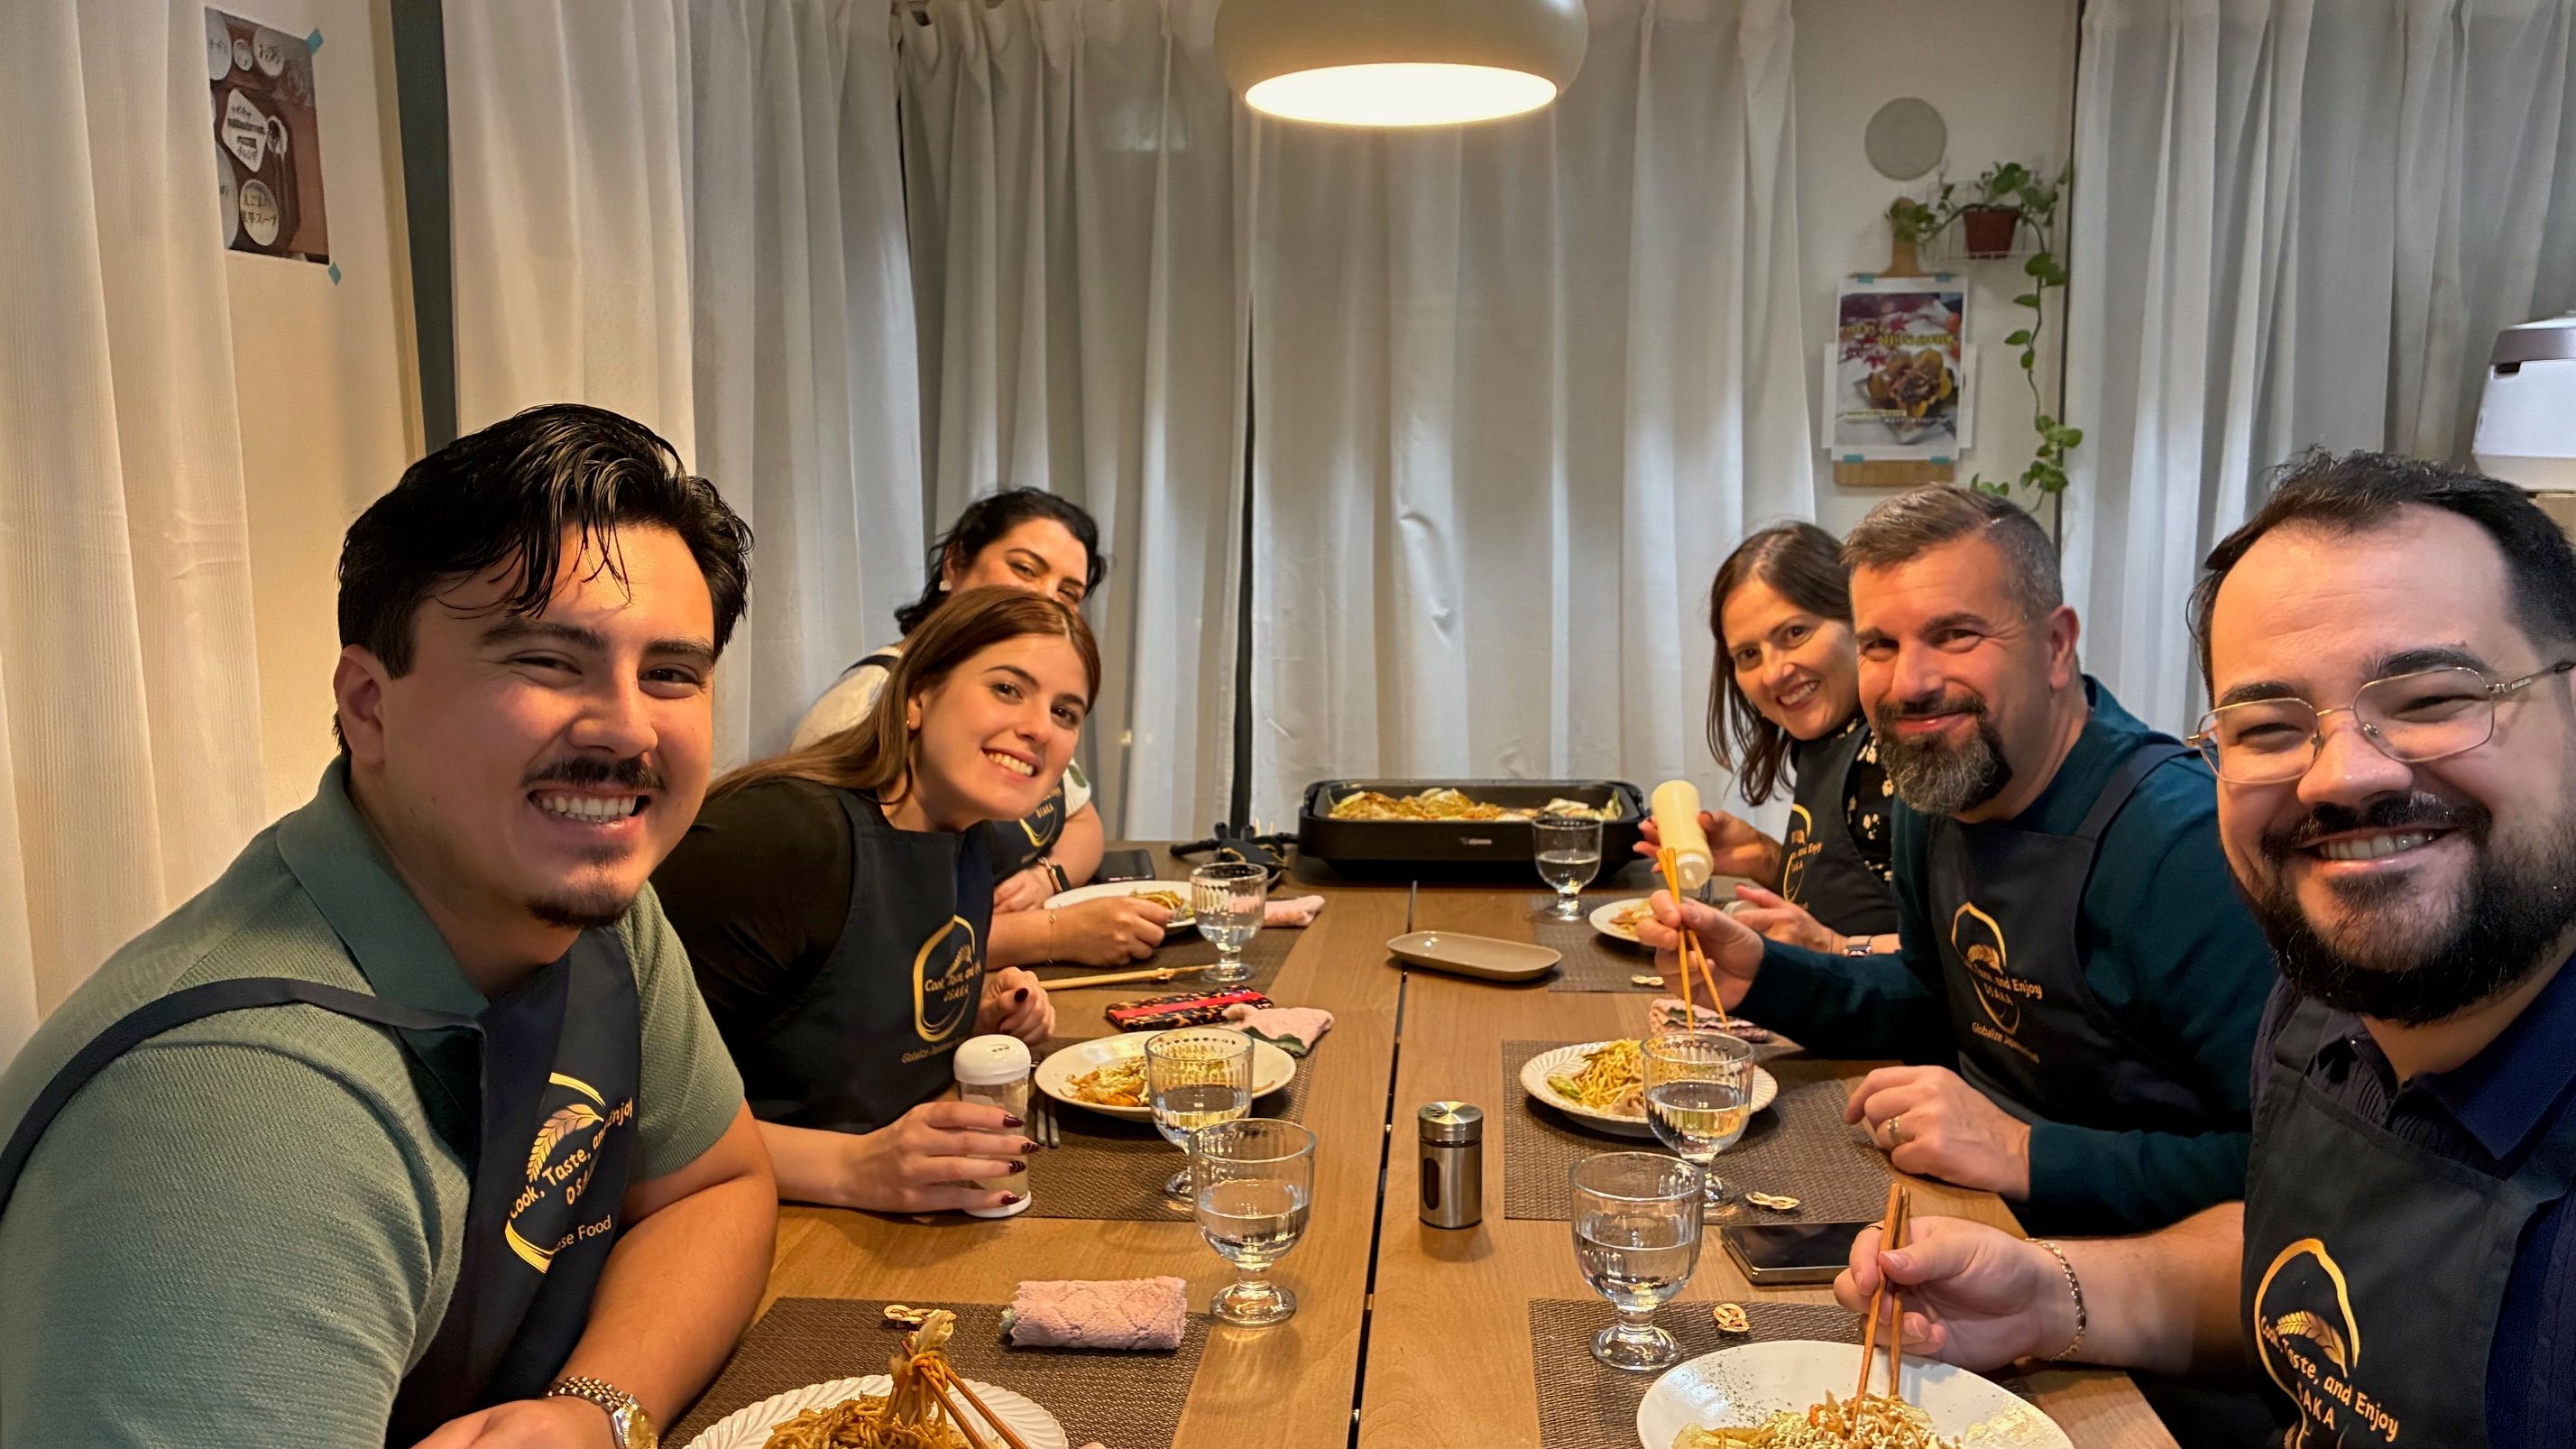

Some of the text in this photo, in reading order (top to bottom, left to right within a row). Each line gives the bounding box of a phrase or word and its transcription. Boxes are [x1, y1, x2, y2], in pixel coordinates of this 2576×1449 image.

[2011, 977, 2043, 1001] Enjoy
[541, 1149, 592, 1186] Taste,
[577, 1214, 612, 1241] Food
[2323, 1375, 2353, 1407] and
[2354, 1391, 2399, 1443] Enjoy
